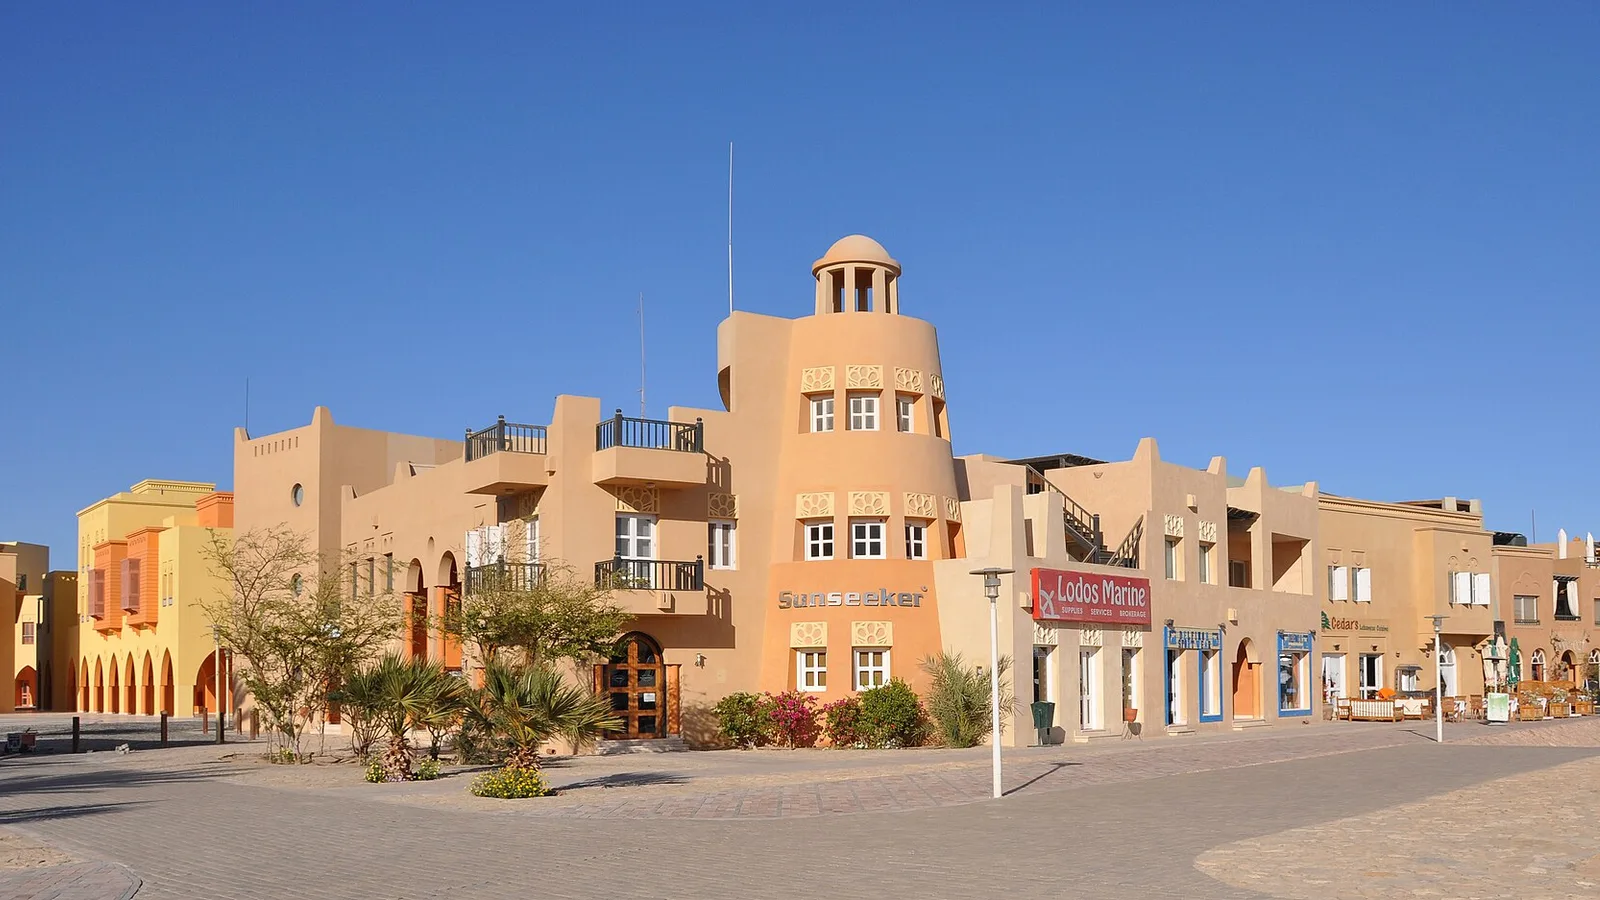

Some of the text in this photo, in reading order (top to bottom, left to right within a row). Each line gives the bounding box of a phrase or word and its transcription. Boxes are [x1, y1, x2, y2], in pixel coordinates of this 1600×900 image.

[779, 588, 924, 609] Sunseeker
[1057, 575, 1146, 607] Lodos Marine
[1061, 606, 1146, 618] SUPPLIES SERVICES BROKERAGE
[1331, 616, 1359, 630] Cedars
